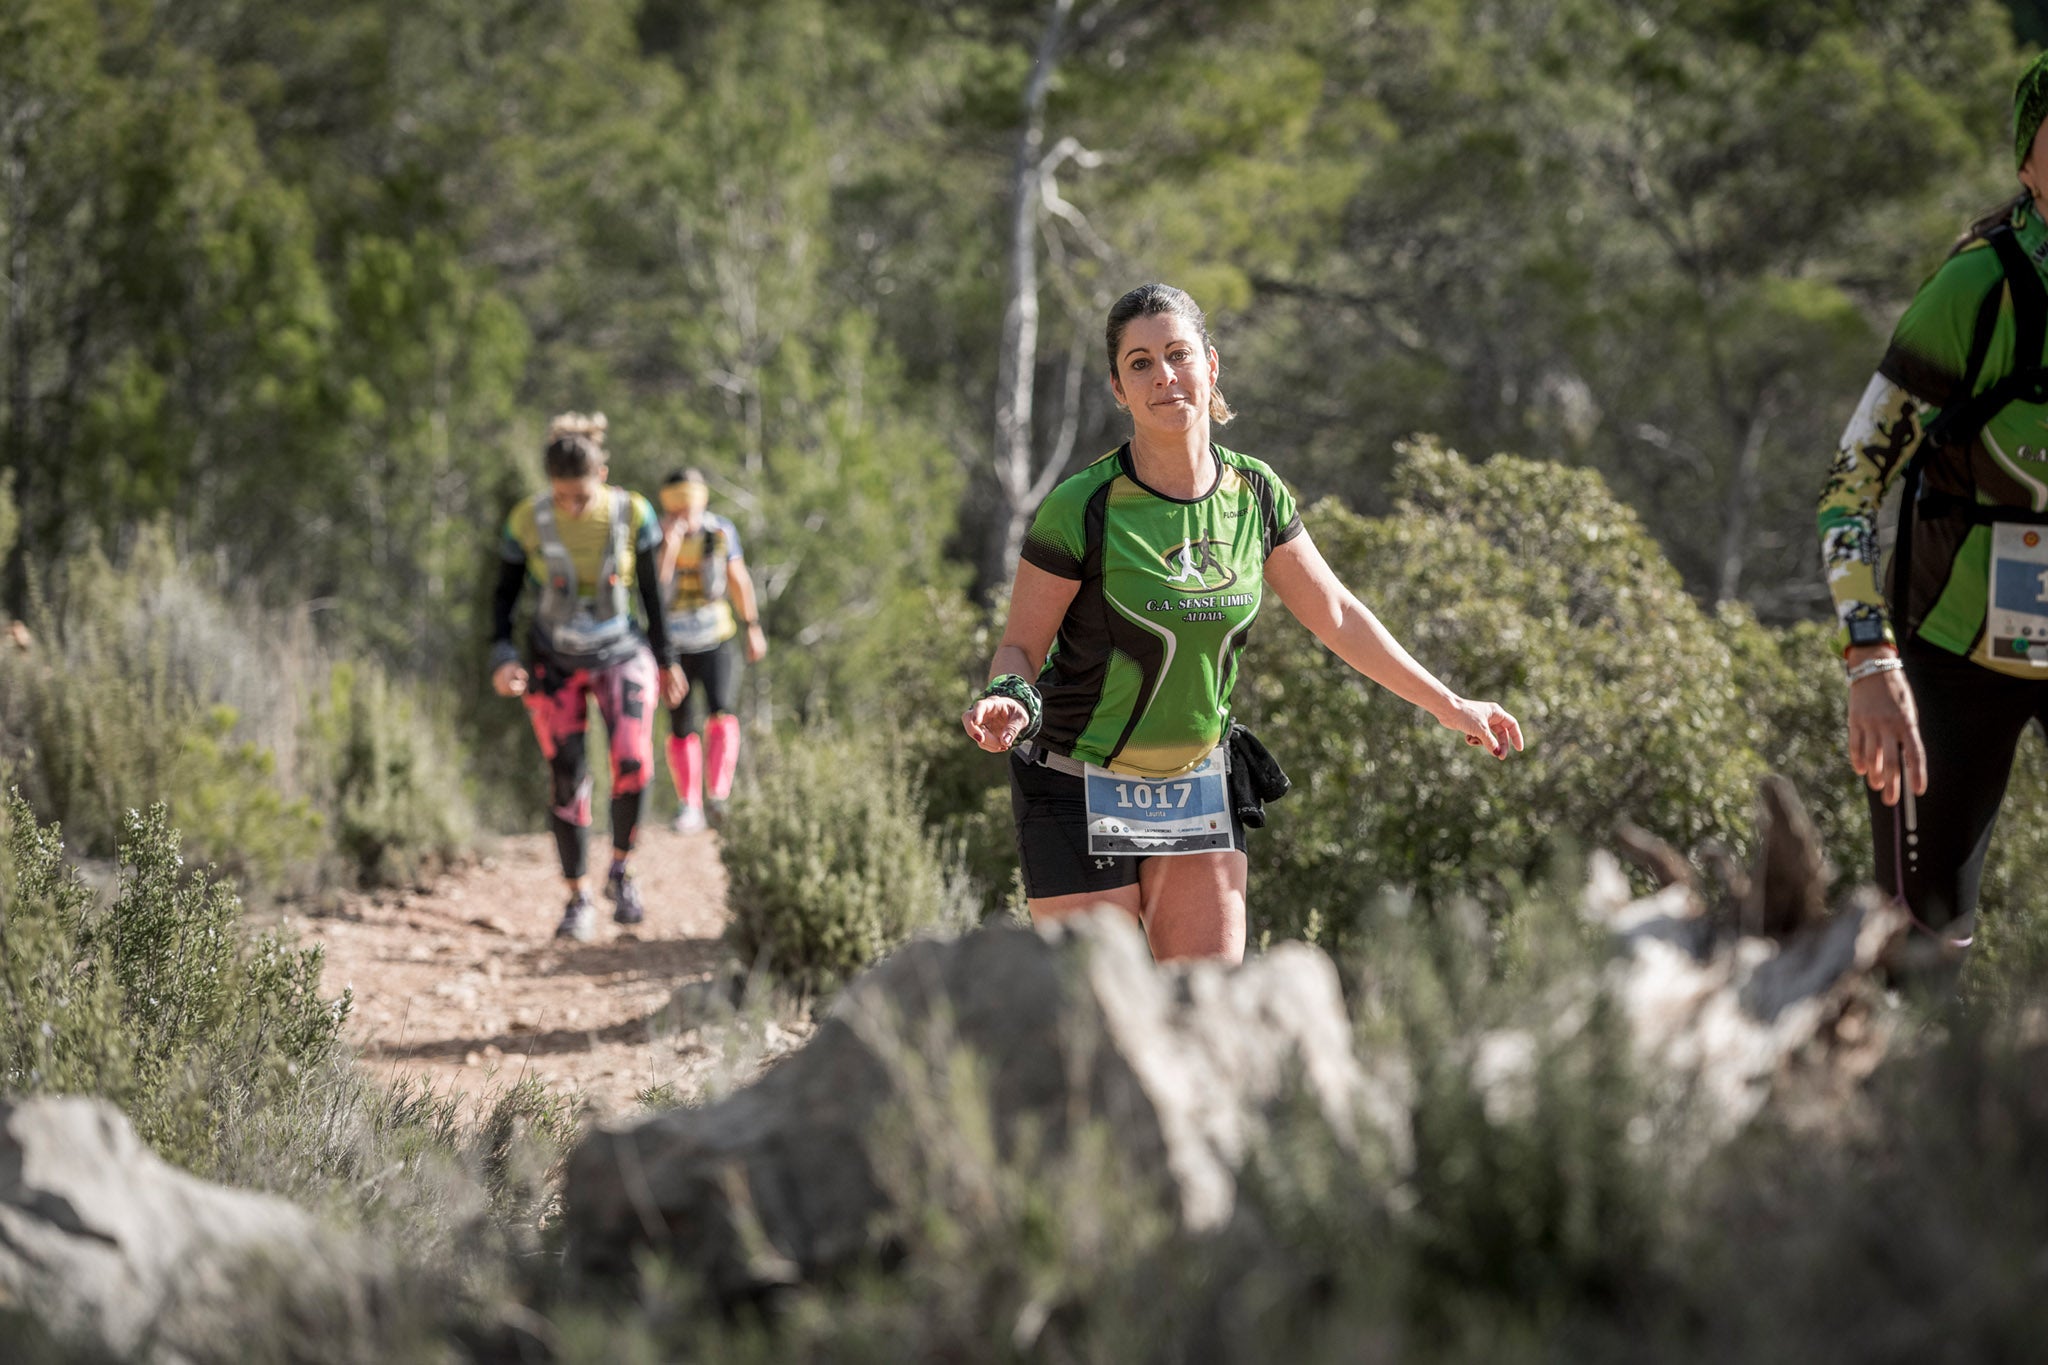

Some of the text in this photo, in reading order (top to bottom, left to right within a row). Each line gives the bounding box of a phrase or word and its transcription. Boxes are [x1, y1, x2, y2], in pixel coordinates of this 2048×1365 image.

[1146, 593, 1254, 611] C.A. SENSE LIMITS
[1115, 783, 1192, 809] 1017
